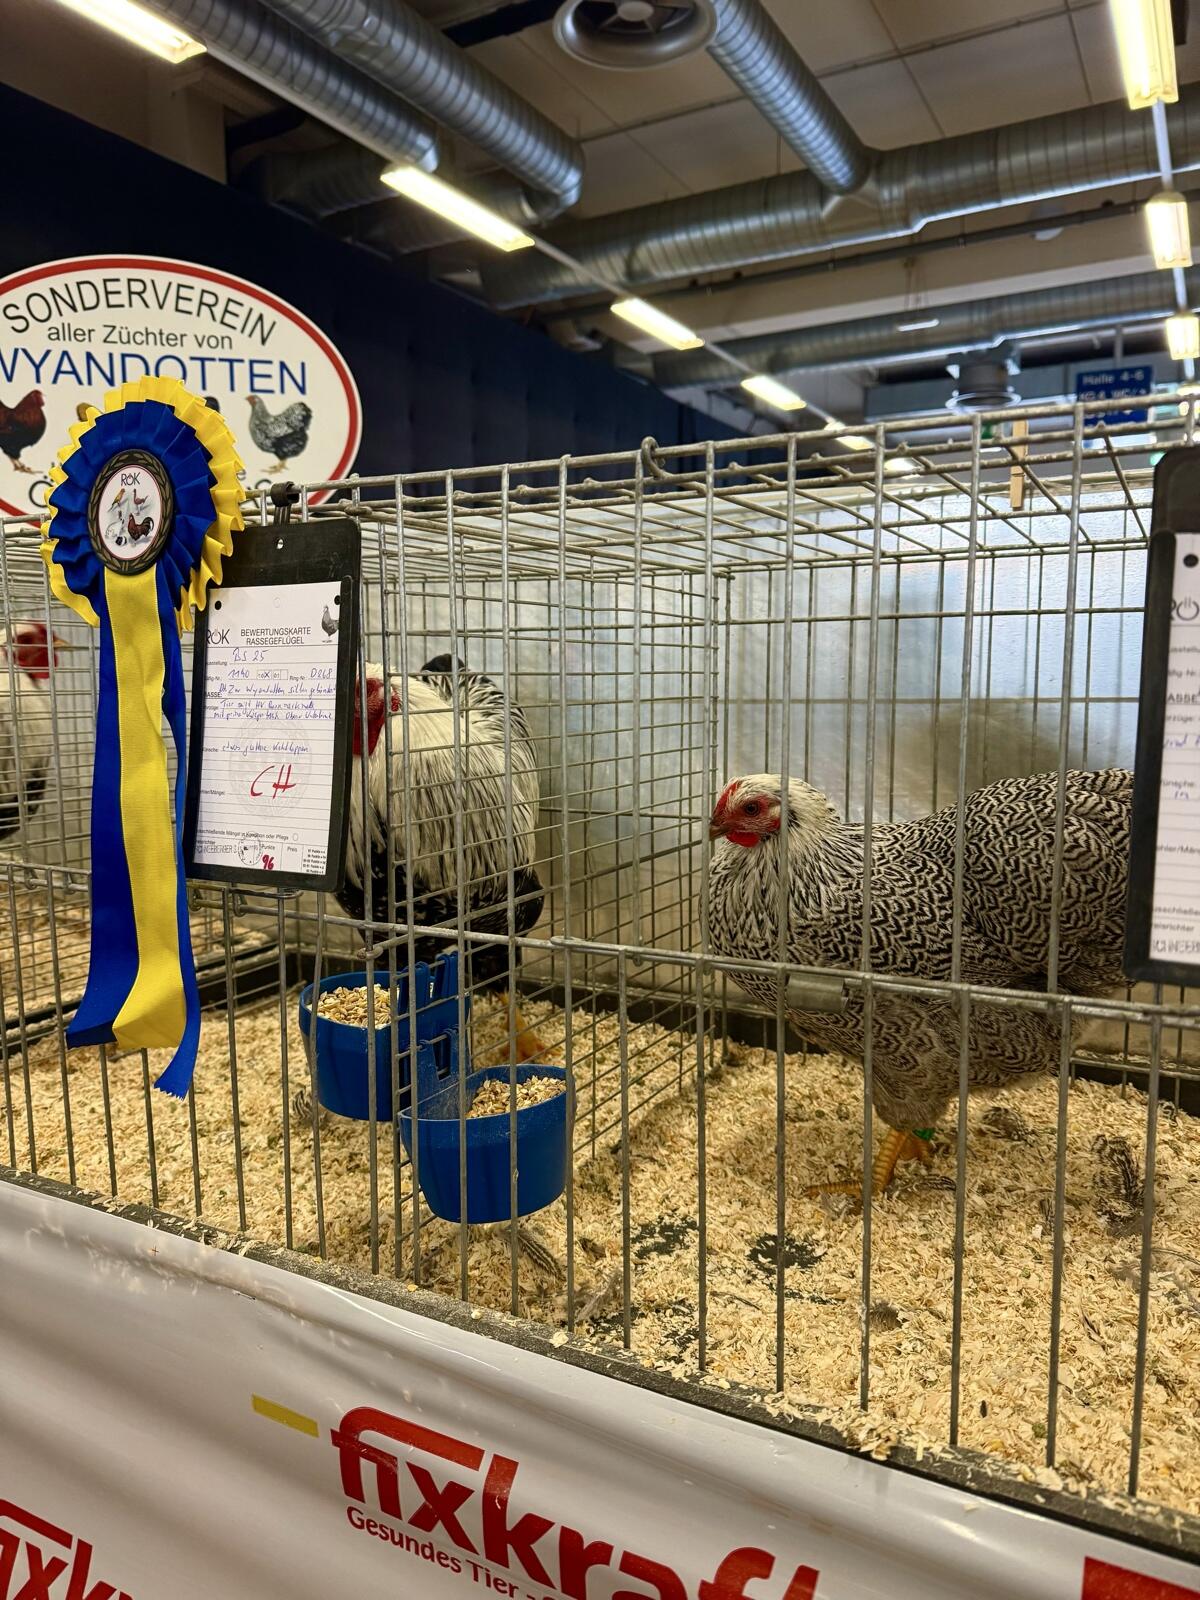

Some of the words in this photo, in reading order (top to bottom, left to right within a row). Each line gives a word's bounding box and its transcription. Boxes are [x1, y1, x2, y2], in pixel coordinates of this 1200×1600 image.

[2, 278, 276, 346] SONDERVEREIN
[47, 322, 95, 343] aller
[102, 325, 187, 348] Züchter
[194, 334, 233, 350] von
[241, 626, 311, 637] BEWERTUNGSKARTE
[246, 635, 304, 646] RASSEGEFLÜGEL
[250, 764, 296, 799] CH
[262, 854, 275, 870] 96
[347, 1505, 462, 1574] Gesundes
[466, 1559, 519, 1598] Tier
